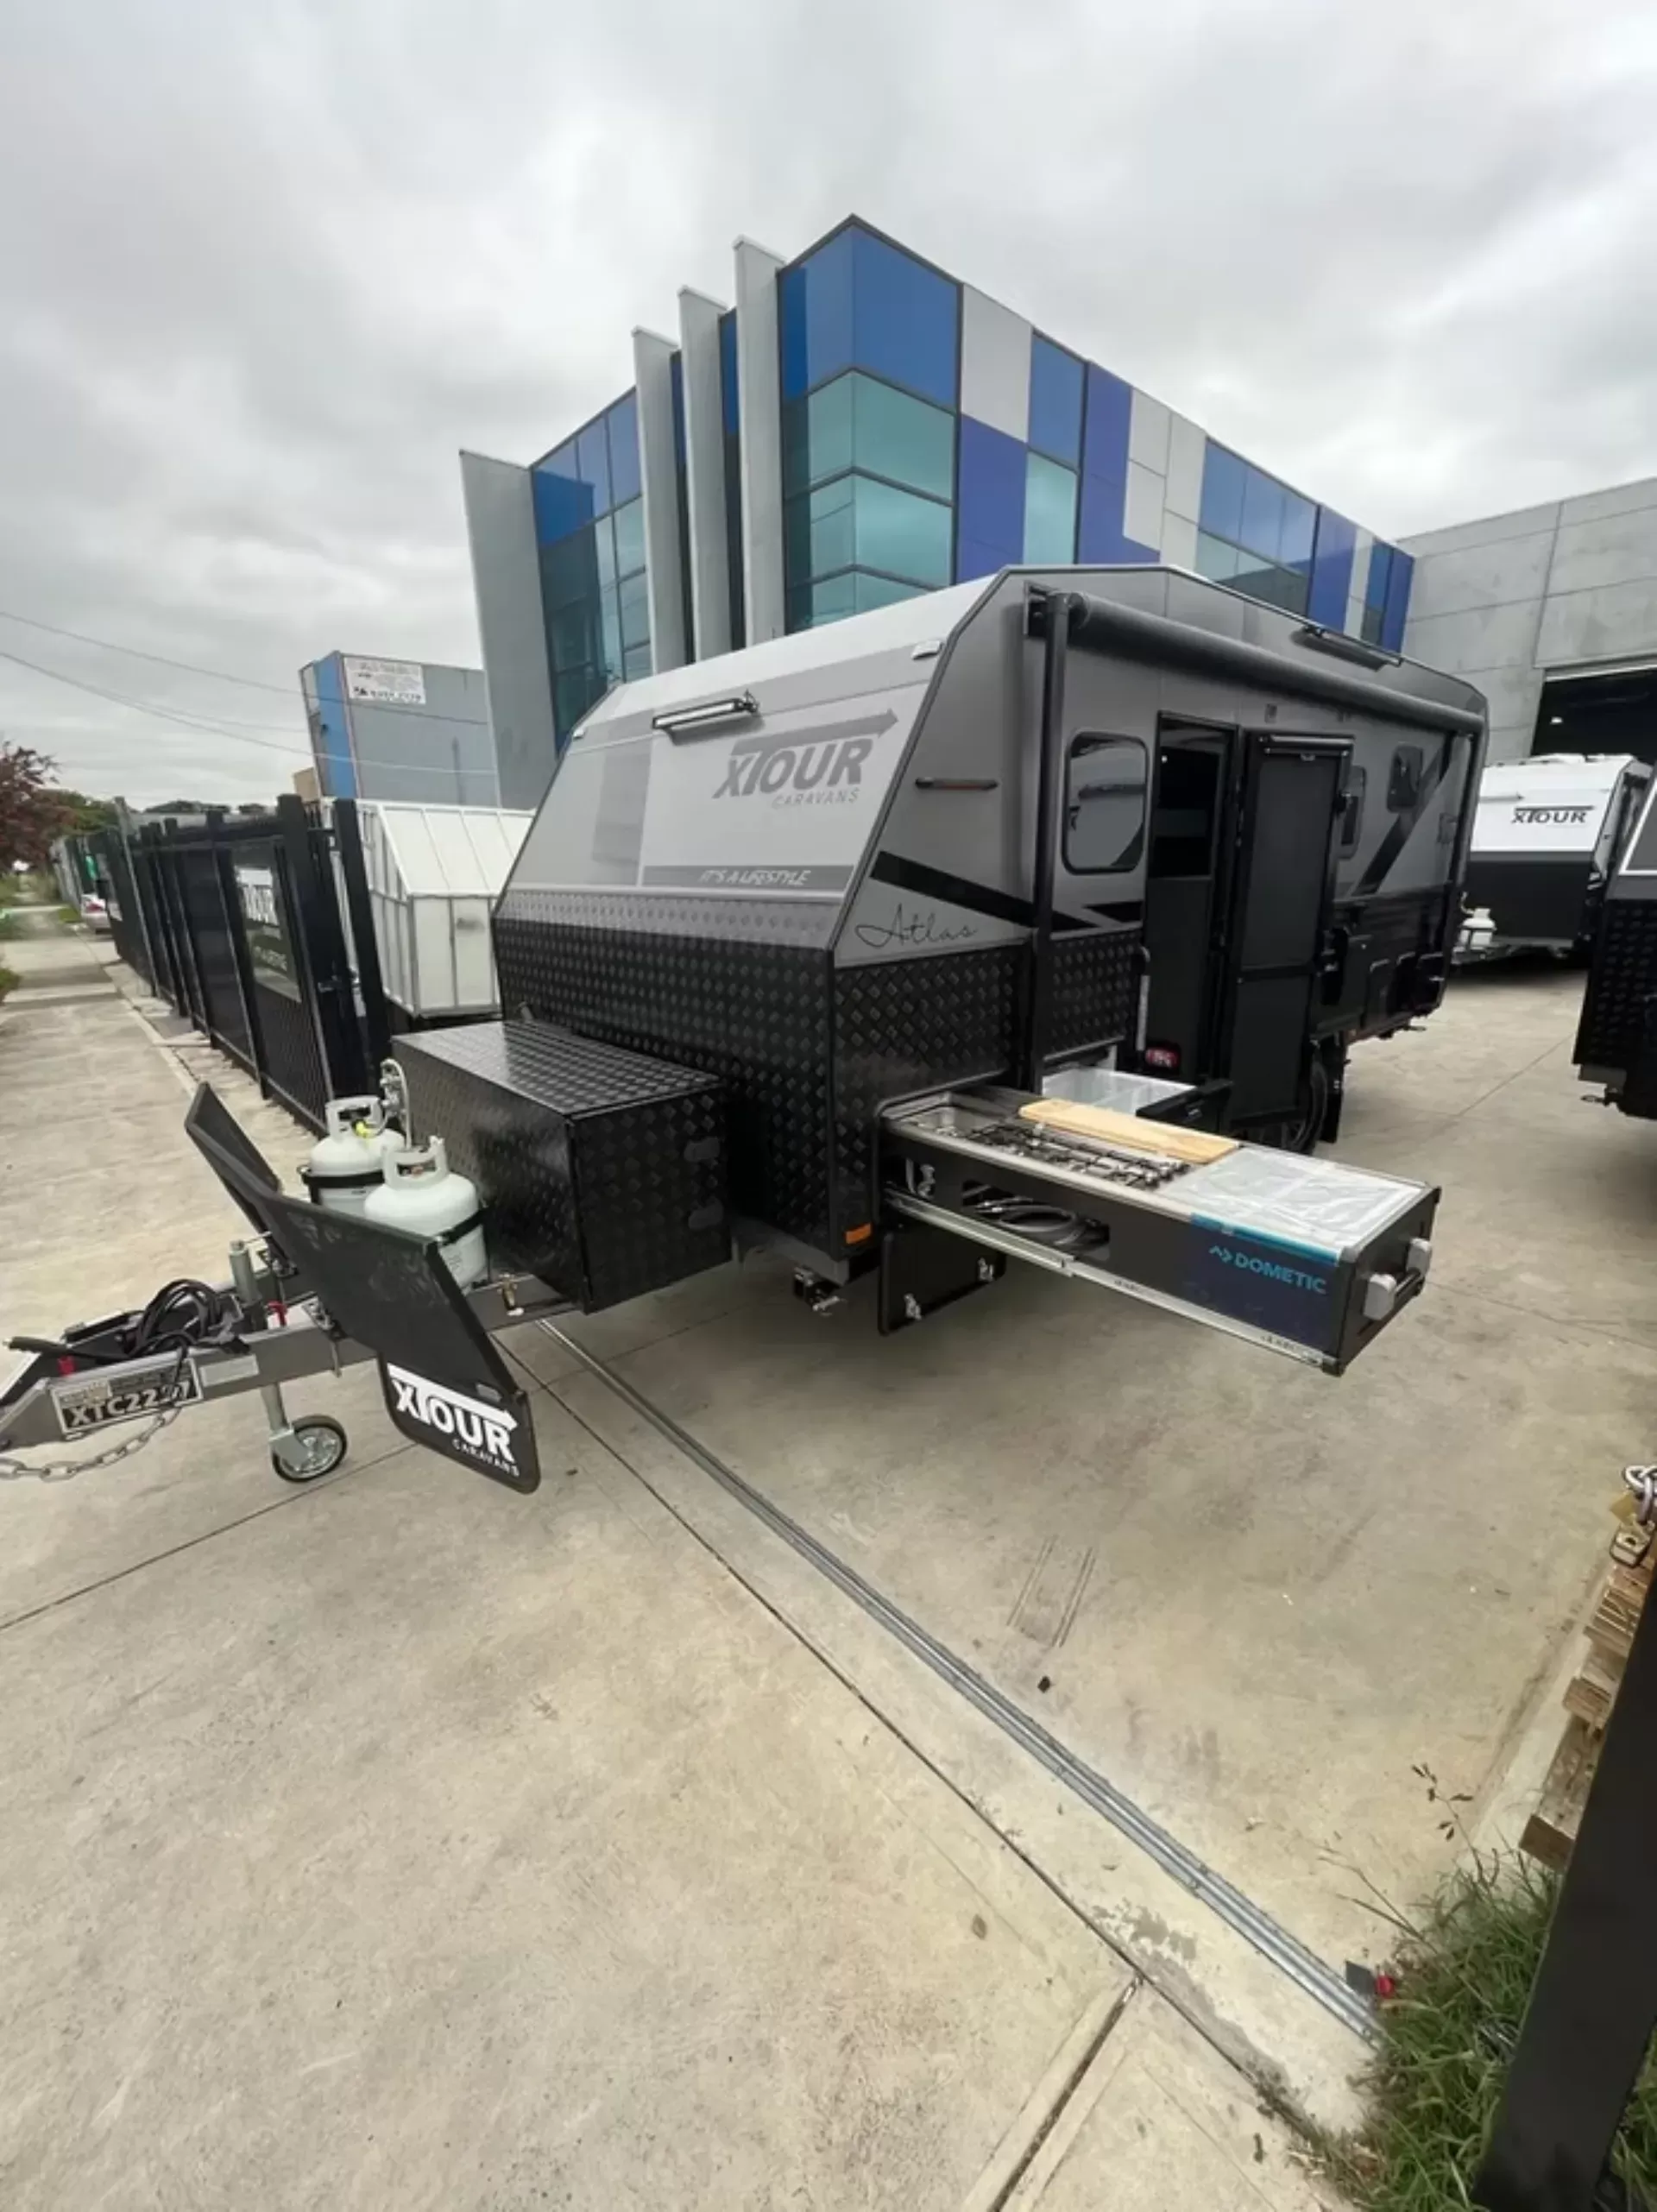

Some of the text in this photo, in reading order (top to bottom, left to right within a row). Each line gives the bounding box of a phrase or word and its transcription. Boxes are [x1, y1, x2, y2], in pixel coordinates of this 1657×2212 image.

[712, 737, 873, 799] XTOUR
[772, 786, 860, 810] CARAVANS
[854, 904, 979, 948] Atlas
[1234, 1252, 1327, 1295] DOMETIC
[391, 1378, 516, 1464] XTOUR
